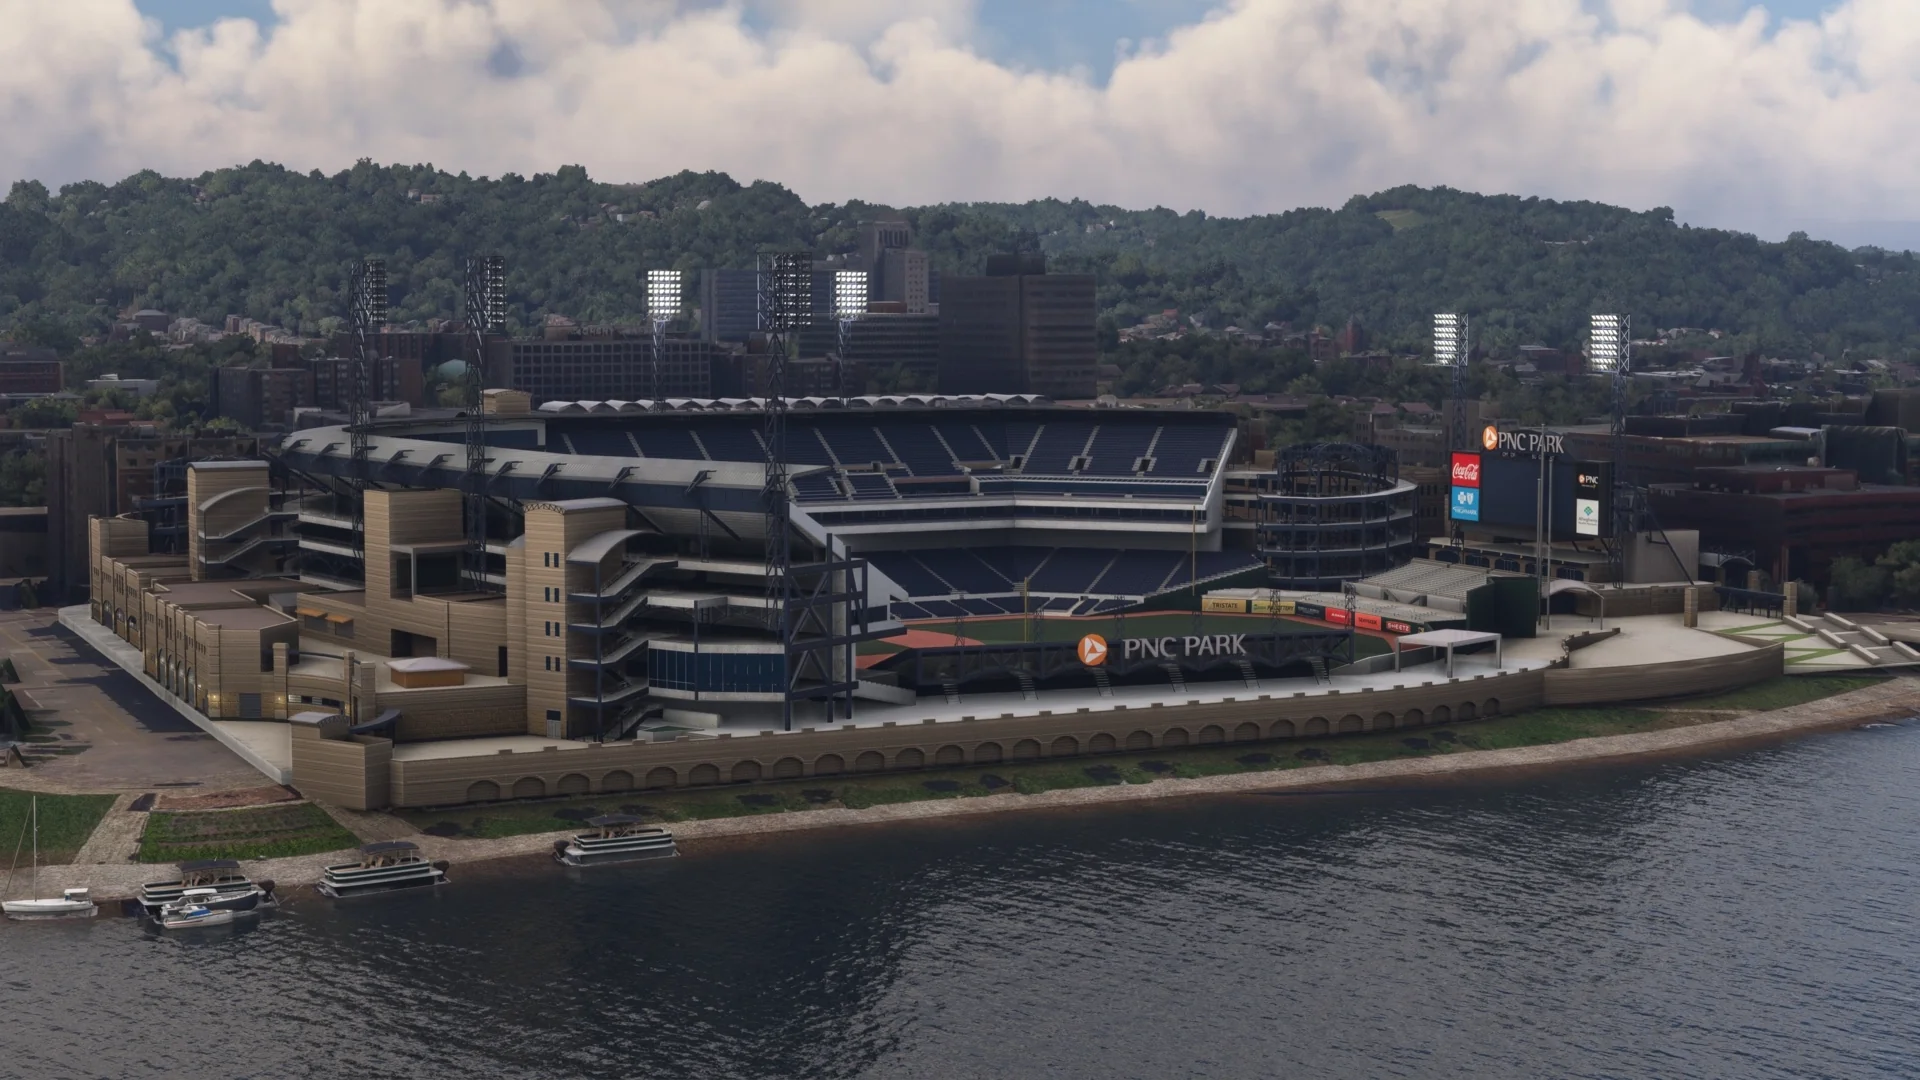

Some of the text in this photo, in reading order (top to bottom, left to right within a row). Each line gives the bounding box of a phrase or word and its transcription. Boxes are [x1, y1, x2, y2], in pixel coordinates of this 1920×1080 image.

[1498, 432, 1564, 453] PNC PARK
[1453, 462, 1479, 480] Coca-Cola
[1585, 475, 1599, 484] PNC
[1387, 622, 1410, 632] SHEETZ
[1122, 633, 1248, 659] PNC PARK
